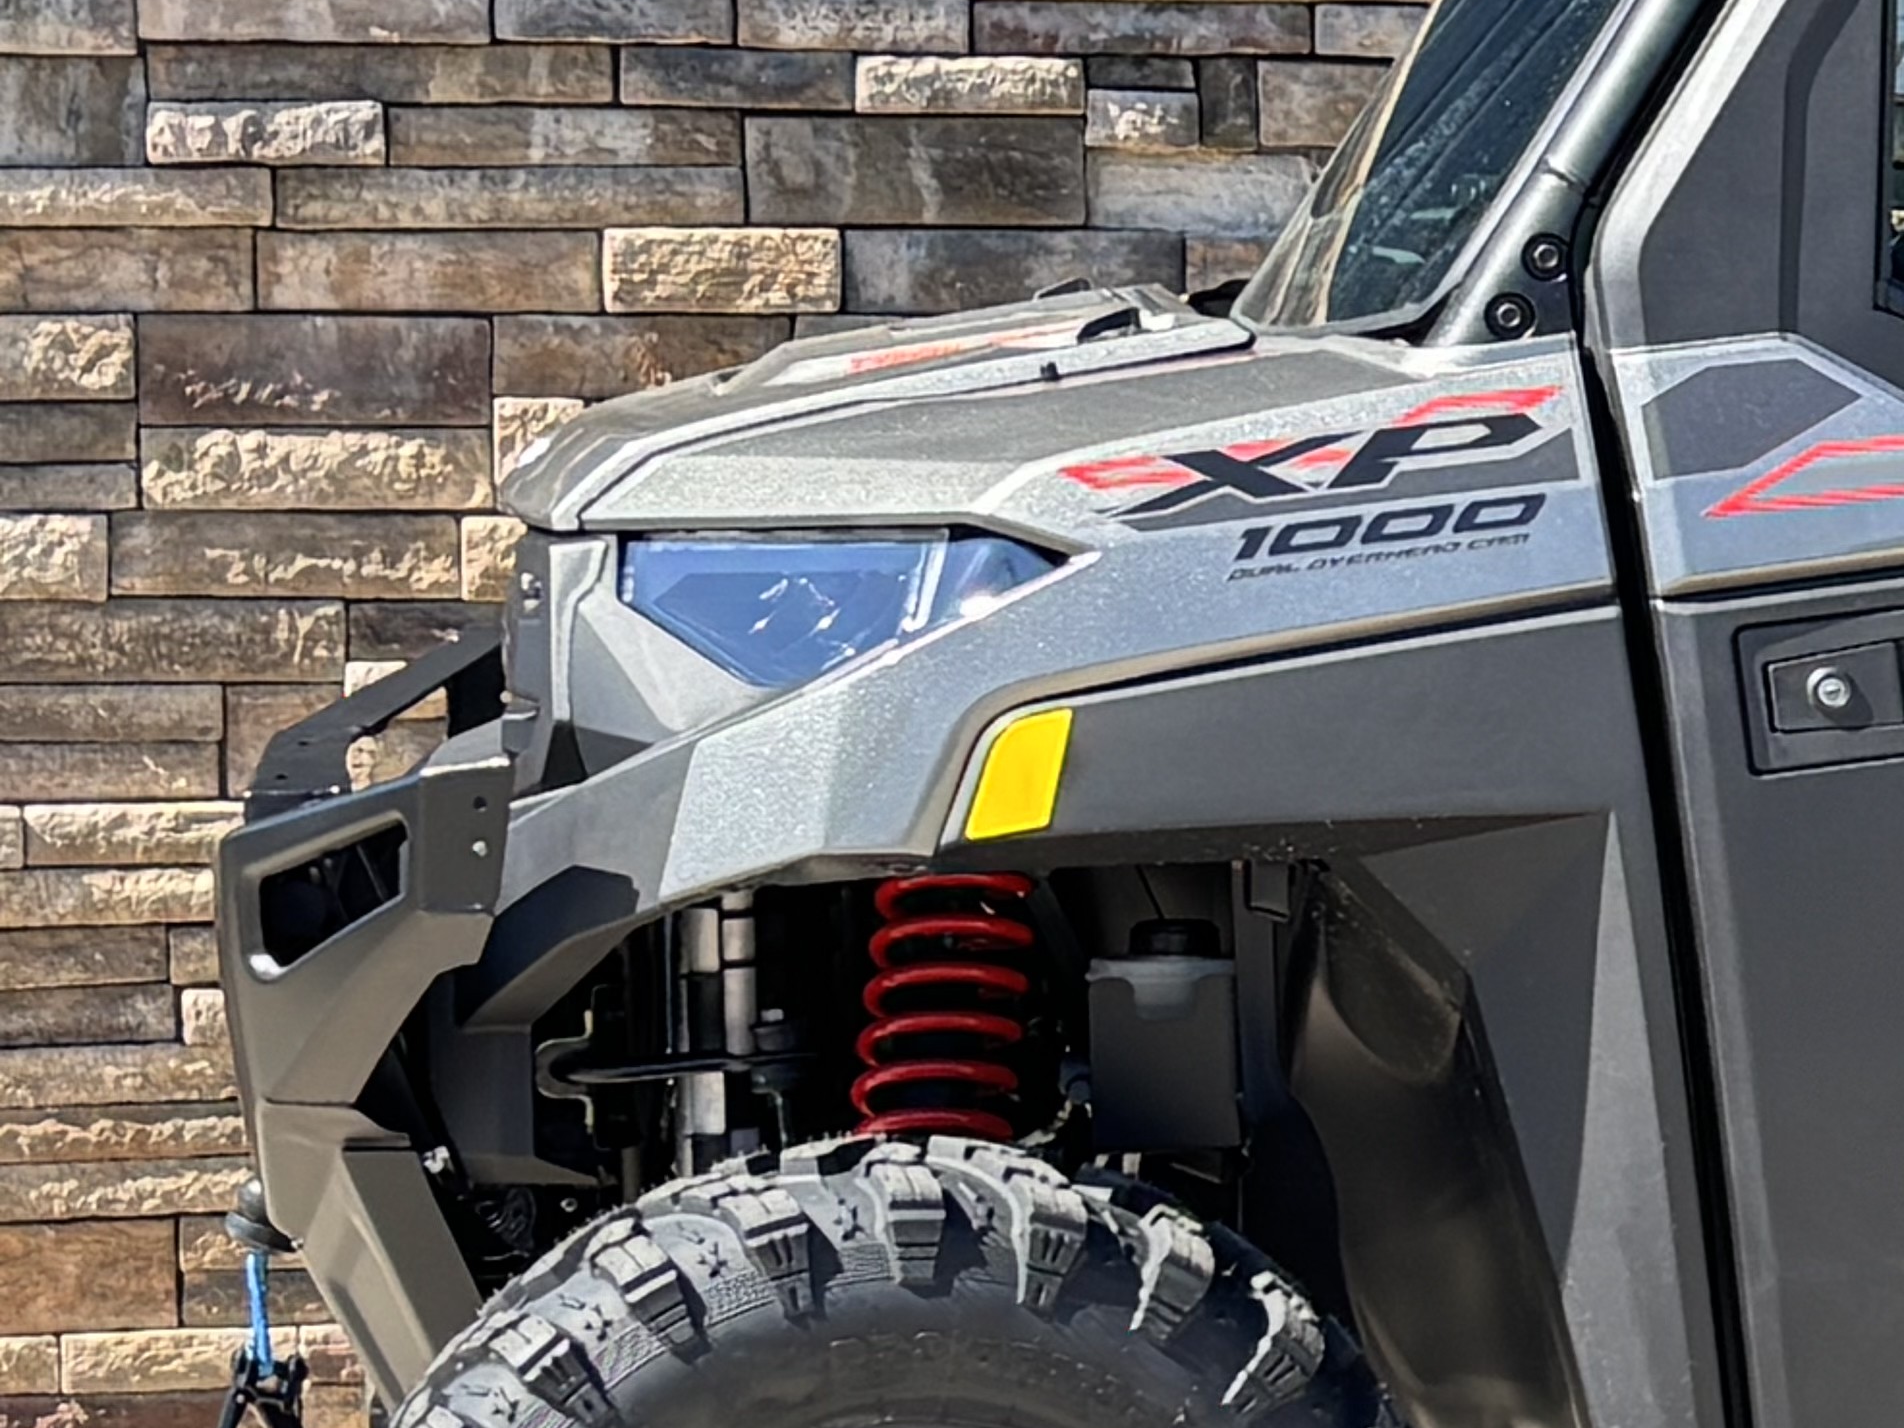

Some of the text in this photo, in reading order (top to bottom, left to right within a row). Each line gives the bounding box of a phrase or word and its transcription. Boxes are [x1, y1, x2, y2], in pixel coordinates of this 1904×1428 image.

[1104, 412, 1543, 519] XP
[1233, 492, 1548, 561] 1000
[1226, 564, 1299, 583] DUAL
[1306, 540, 1462, 570] OVERHEAD
